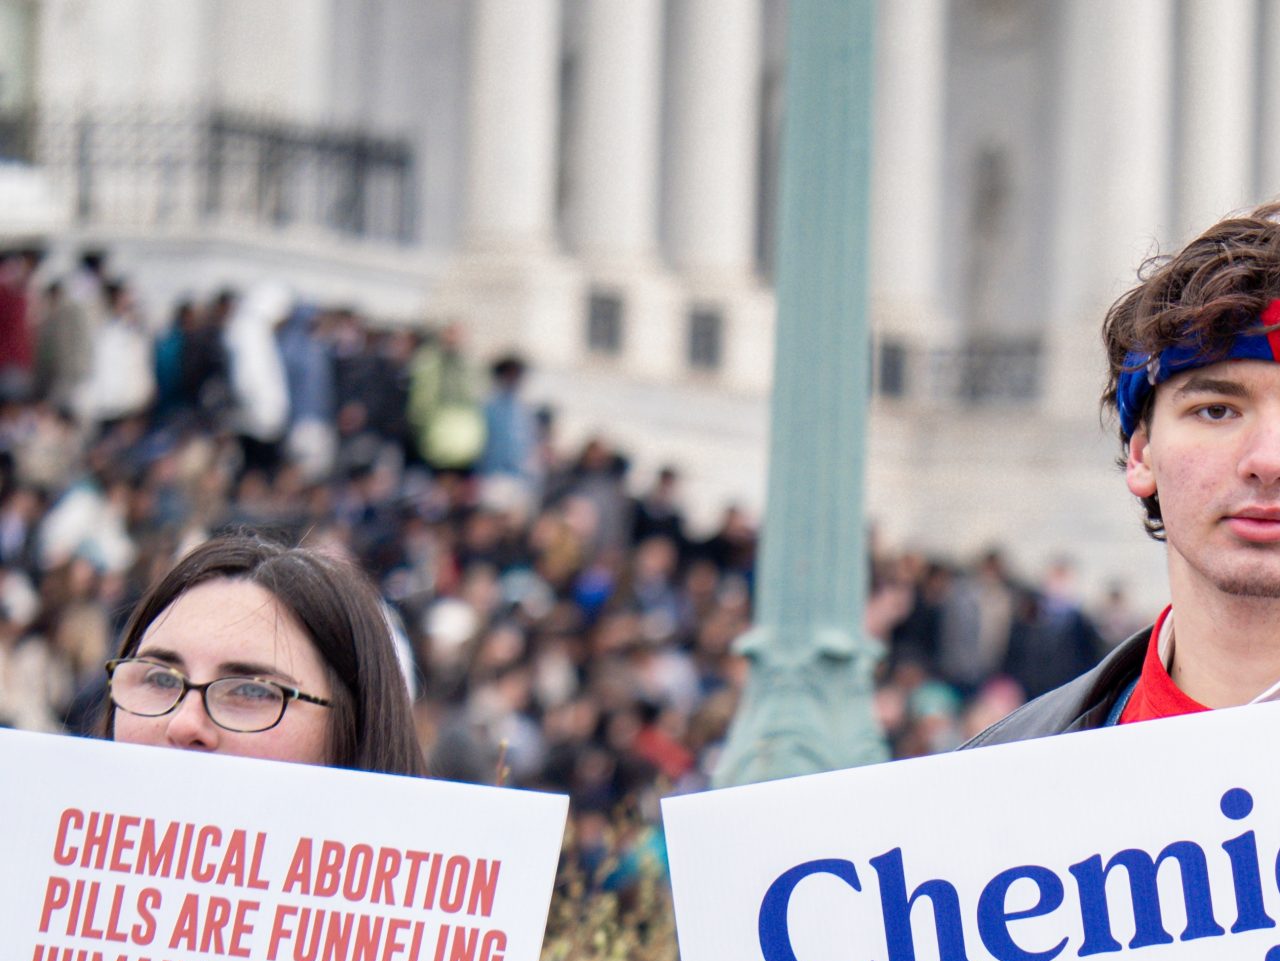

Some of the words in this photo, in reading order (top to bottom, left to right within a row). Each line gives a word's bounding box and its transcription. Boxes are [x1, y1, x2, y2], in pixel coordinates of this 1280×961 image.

[54, 808, 269, 889] CHEMICAL
[283, 838, 501, 917] ABORTION
[39, 877, 162, 945] PILLS
[168, 893, 260, 957] ARE
